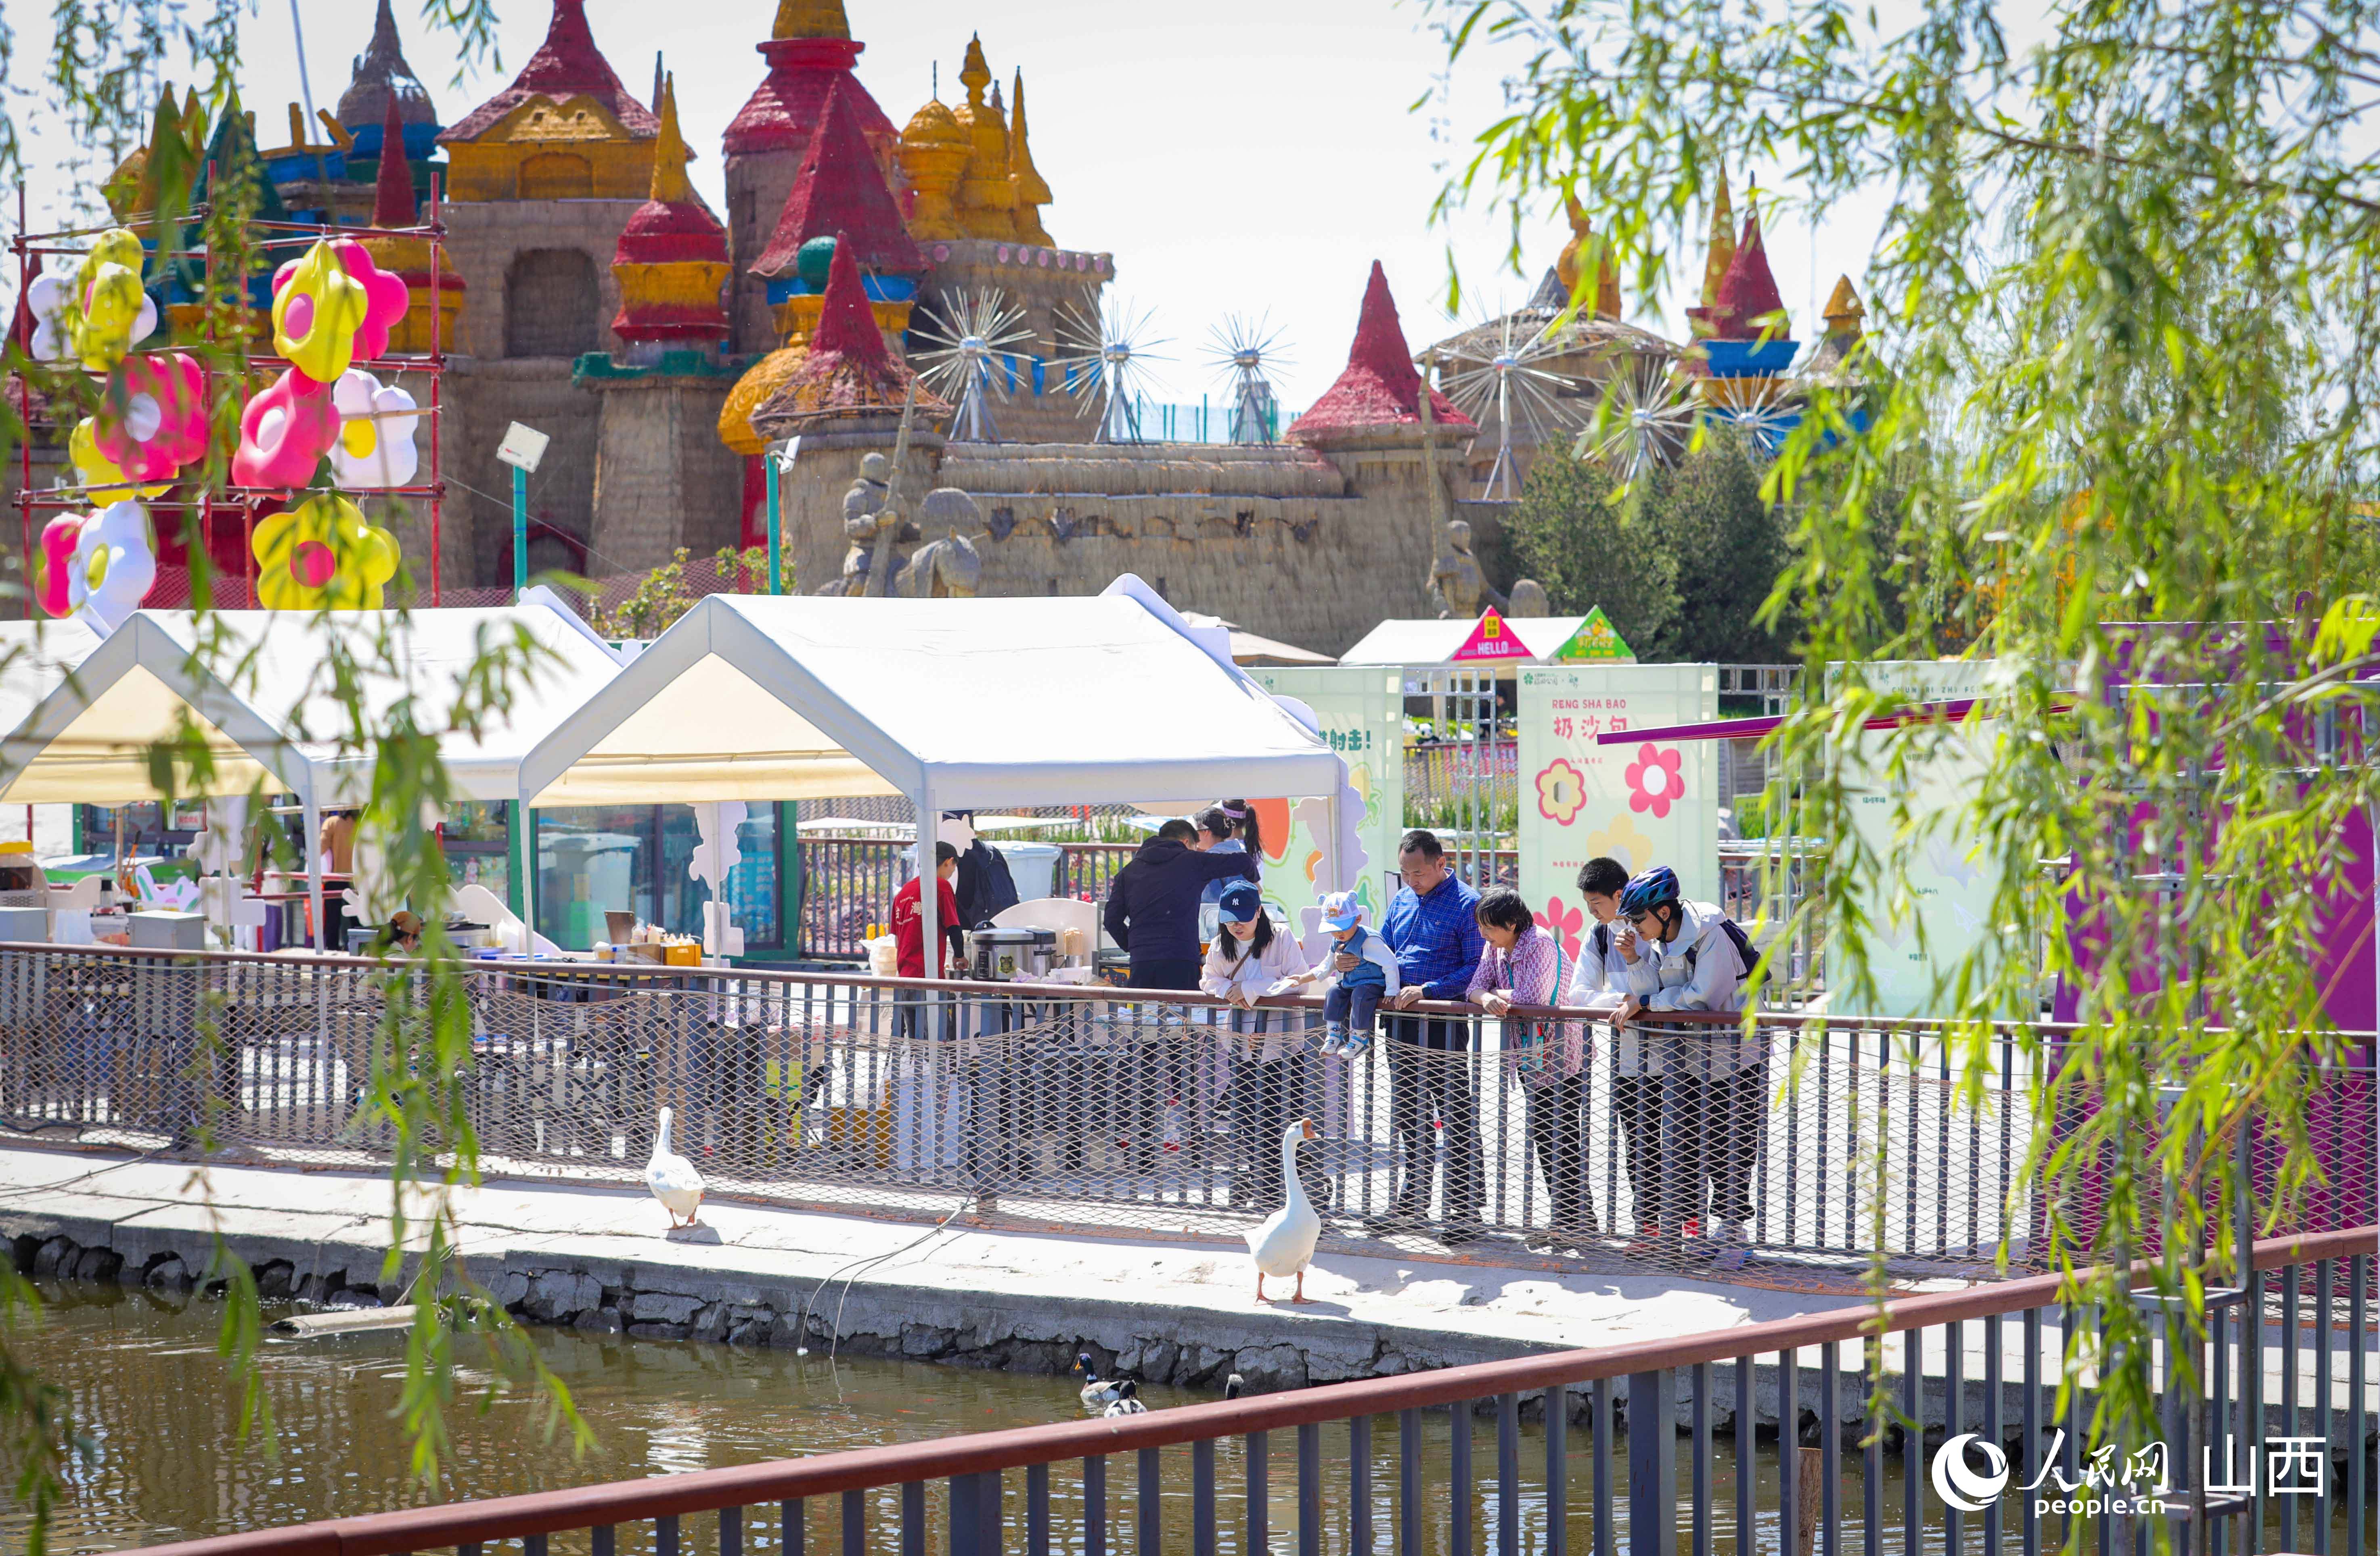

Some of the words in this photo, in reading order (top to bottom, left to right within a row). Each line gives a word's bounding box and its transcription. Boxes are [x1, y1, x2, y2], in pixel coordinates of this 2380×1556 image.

[1477, 641, 1509, 655] HELLO
[1552, 699, 1579, 709] RENG
[1582, 699, 1602, 709] SHA
[1606, 699, 1626, 709] BAO
[1554, 715, 1627, 740] 扔沙包
